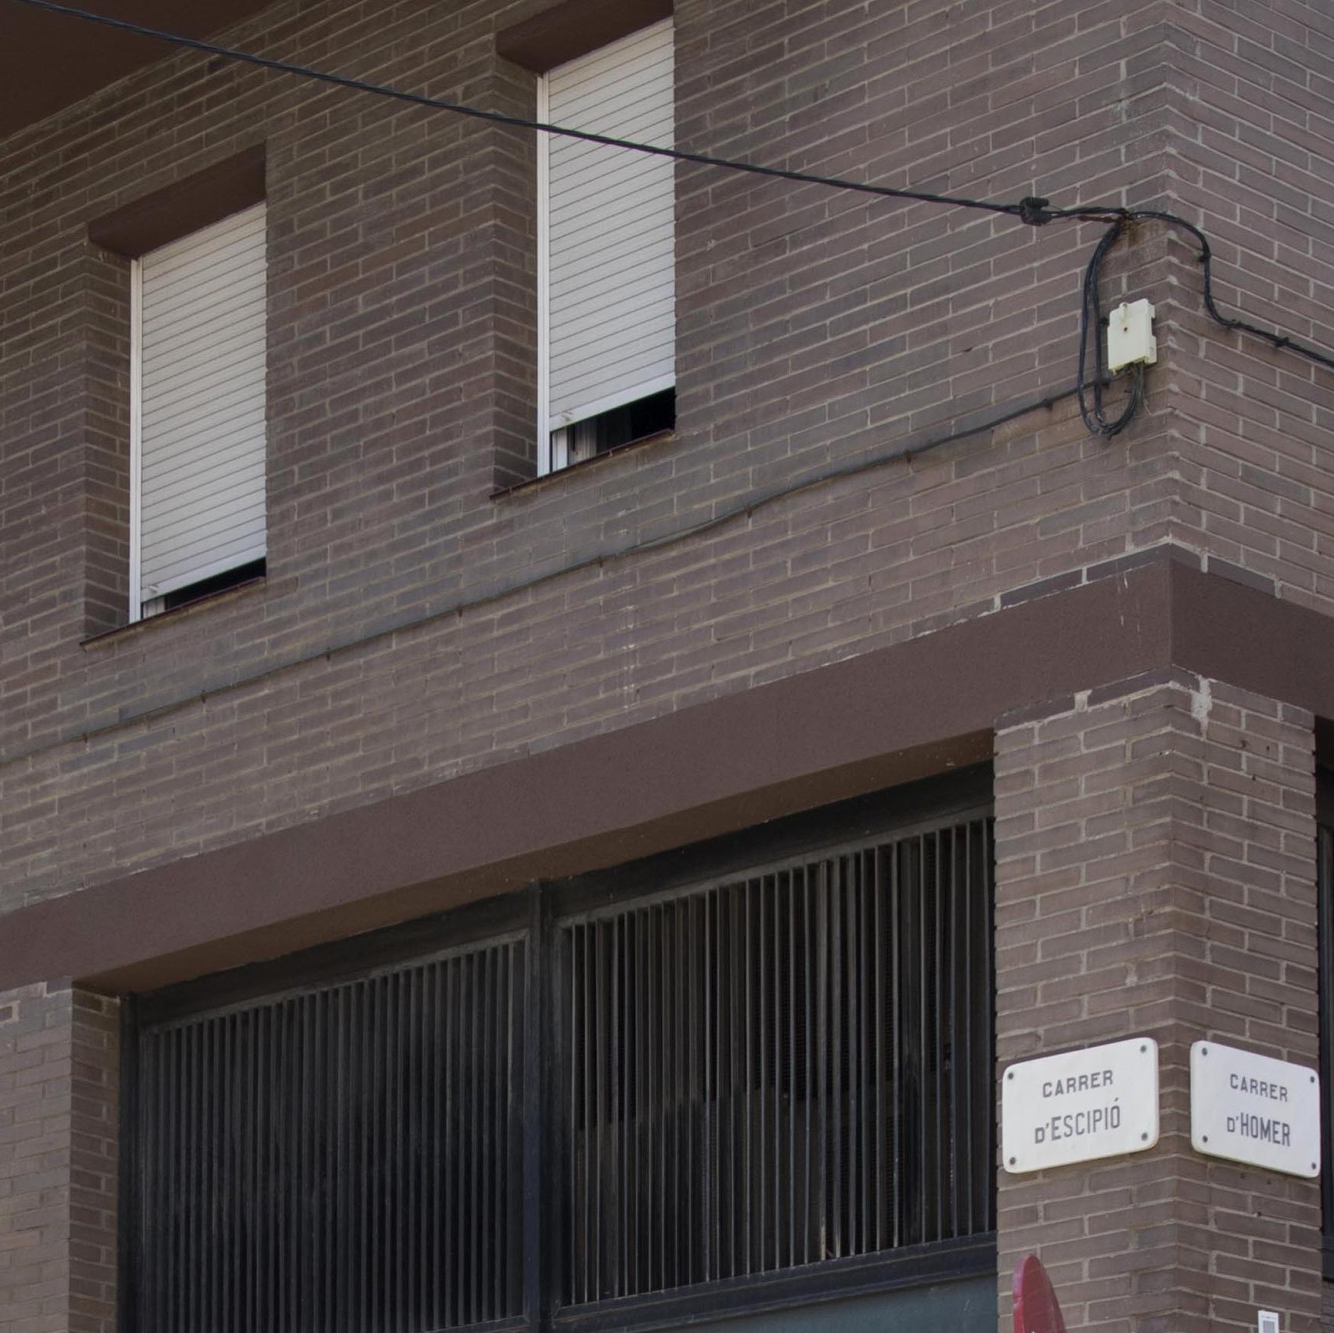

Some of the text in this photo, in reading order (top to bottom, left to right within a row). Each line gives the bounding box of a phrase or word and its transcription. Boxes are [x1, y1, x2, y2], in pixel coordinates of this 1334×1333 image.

[1042, 1069, 1114, 1098] CARRER
[1229, 1073, 1289, 1102] CARRER
[1034, 1097, 1122, 1145] D'ESCIPIÓ
[1226, 1112, 1291, 1147] D'HOMER
